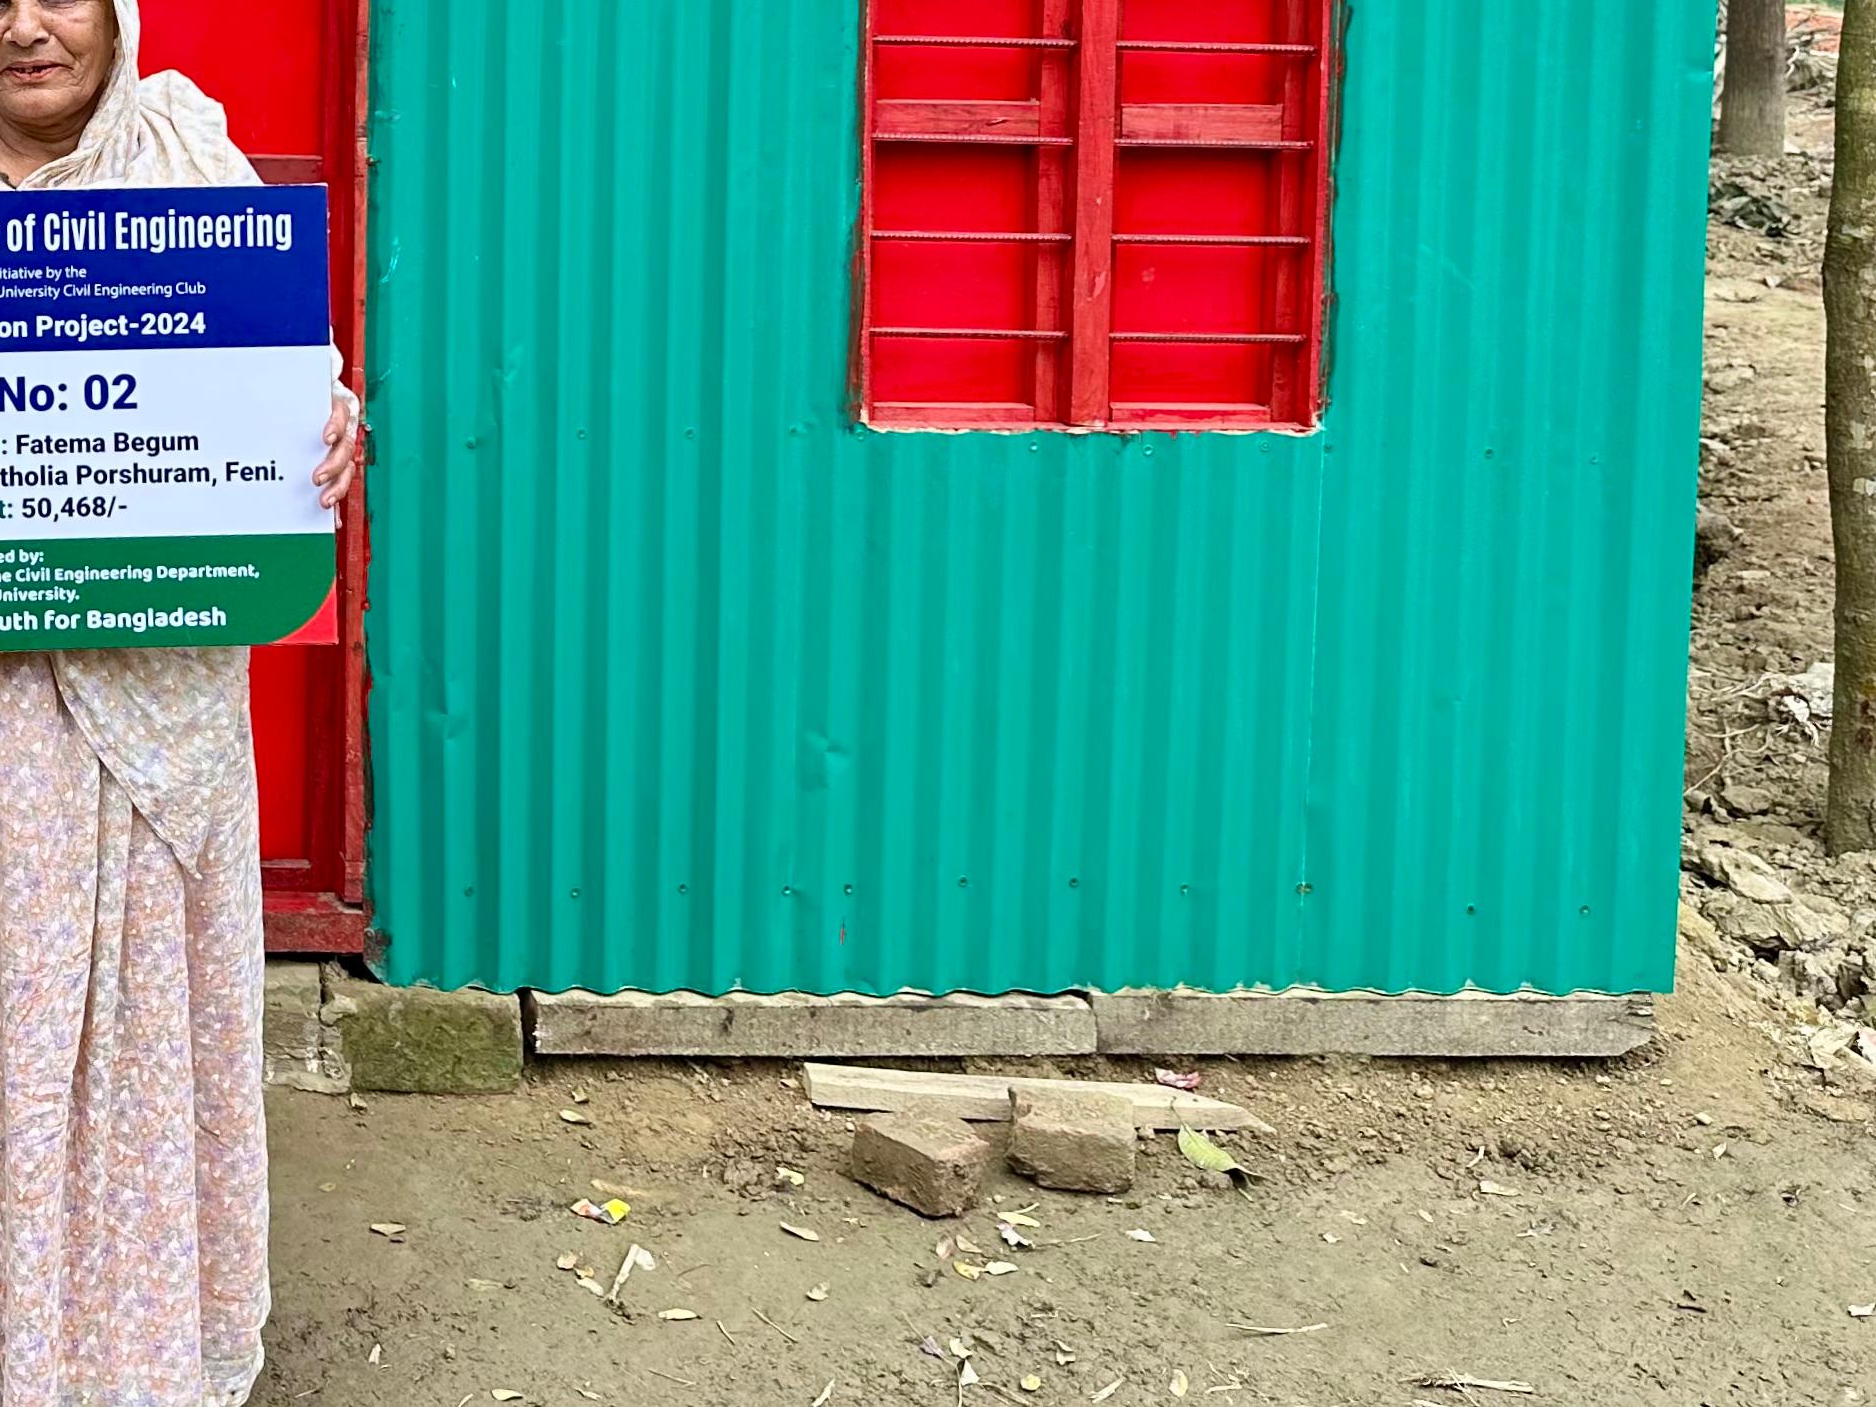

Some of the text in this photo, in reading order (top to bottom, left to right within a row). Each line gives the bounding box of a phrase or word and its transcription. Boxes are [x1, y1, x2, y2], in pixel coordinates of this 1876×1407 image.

[6, 213, 36, 252] of
[43, 210, 105, 252] Civil
[115, 207, 292, 254] Engineering
[45, 265, 63, 282] by
[65, 265, 87, 279] the
[63, 283, 91, 297] Civil
[94, 282, 173, 299] Engineering
[175, 281, 207, 295] Club
[35, 312, 206, 343] Project-2024
[83, 373, 138, 411] 02
[15, 434, 106, 455] Fatema
[113, 432, 199, 457] Begum
[76, 462, 217, 488] Porshuram,
[225, 460, 284, 482] Feni.
[21, 495, 128, 523] 50,468/-
[18, 548, 44, 566] by:
[15, 567, 51, 582] Civil
[54, 565, 153, 584] Engineering
[156, 564, 260, 581] Department,
[44, 609, 81, 630] for
[86, 606, 227, 633] Bangladesh
